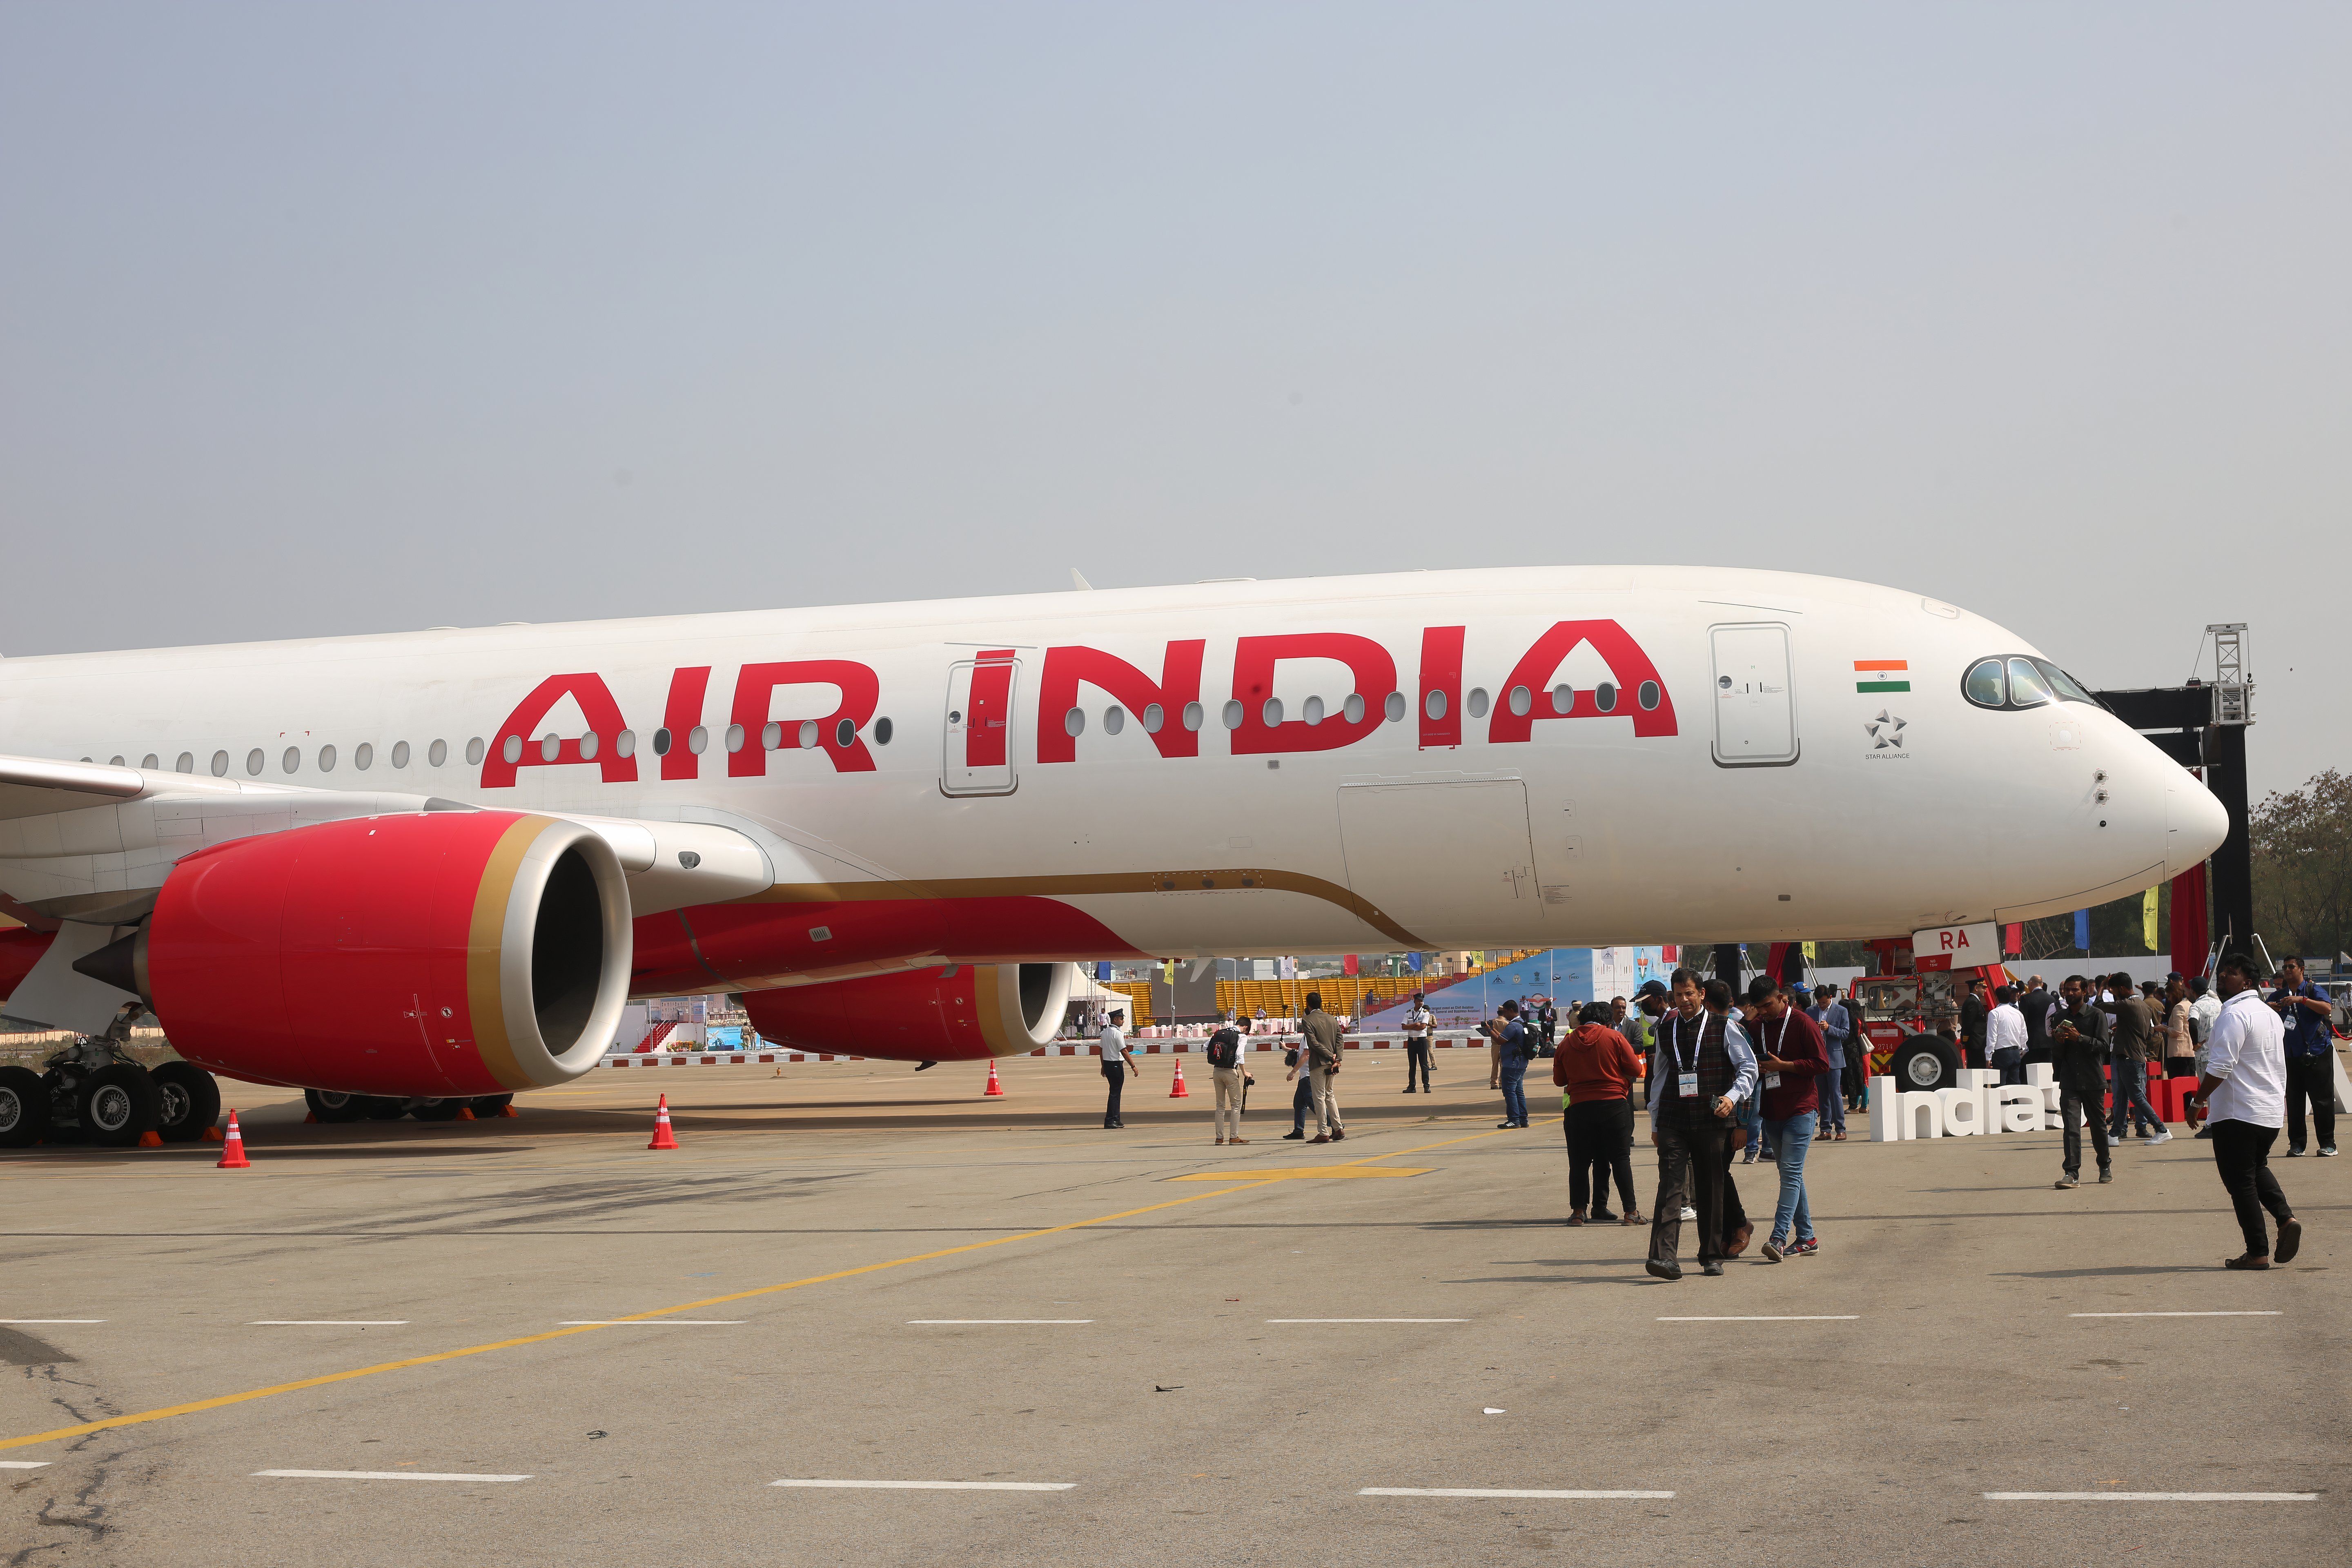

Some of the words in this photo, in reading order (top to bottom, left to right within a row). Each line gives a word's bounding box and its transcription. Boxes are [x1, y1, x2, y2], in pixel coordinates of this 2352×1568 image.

[481, 659, 880, 788] AIR
[966, 619, 1678, 767] INDIA
[1940, 929, 1970, 950] RA
